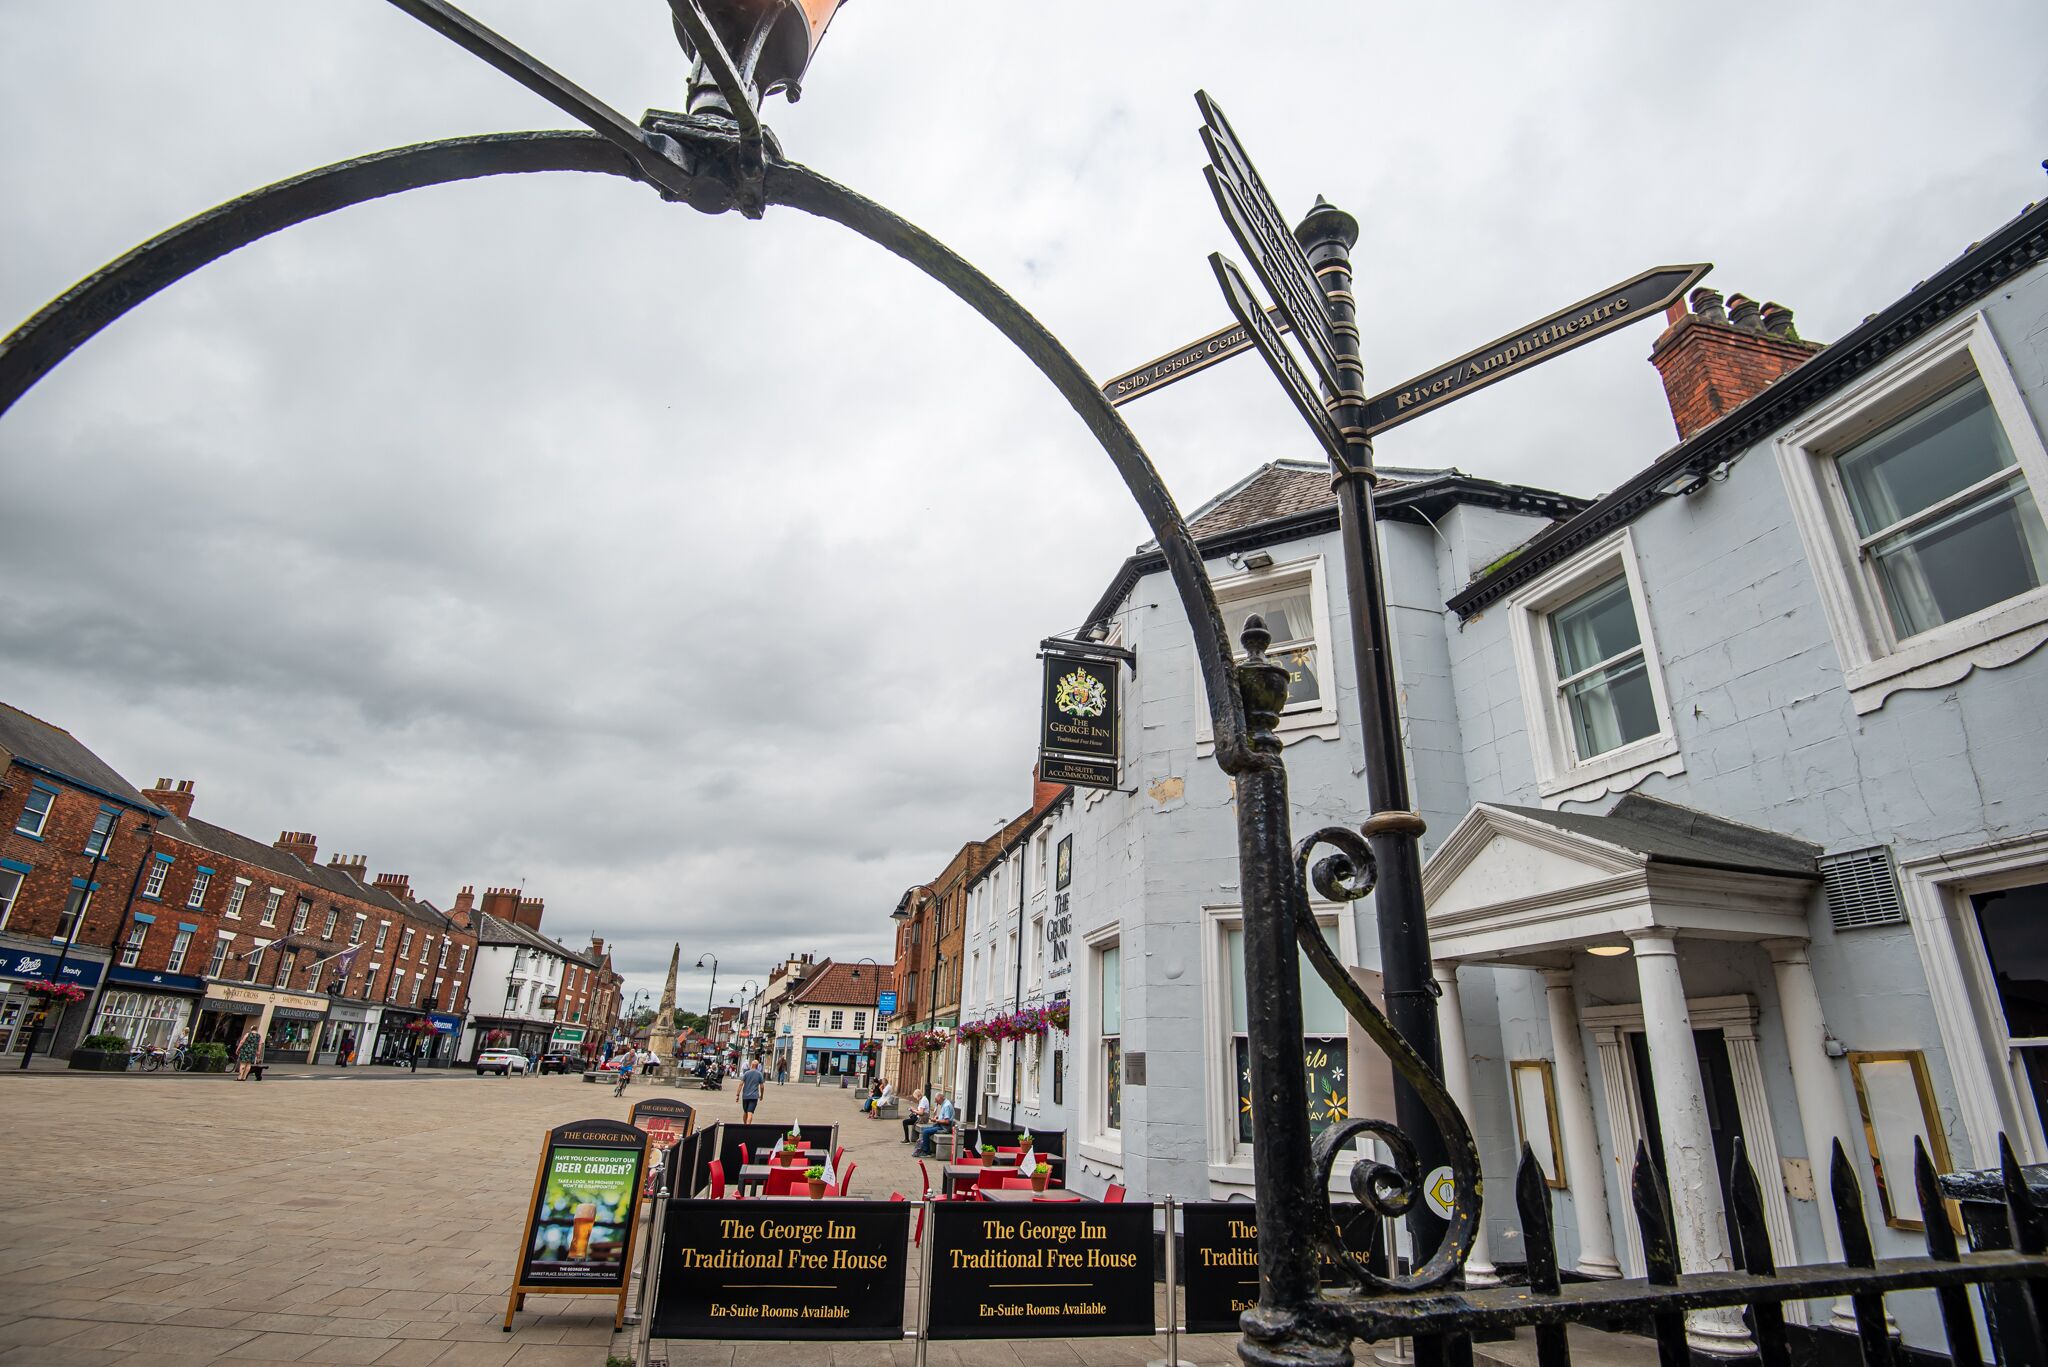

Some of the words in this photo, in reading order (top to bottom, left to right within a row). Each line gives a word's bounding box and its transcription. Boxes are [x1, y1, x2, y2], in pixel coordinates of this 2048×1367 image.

[1116, 373, 1151, 395] Selby
[1154, 350, 1204, 379] Leisure
[1207, 329, 1249, 354] Centr
[1050, 722, 1089, 735] GEORGE
[1092, 727, 1109, 737] INN
[1073, 718, 1088, 726] THE
[1048, 770, 1109, 782] ACCOMMODATION
[1065, 765, 1094, 773] EN-SUITE
[1055, 892, 1070, 917] THE
[1046, 913, 1072, 943] GEORG
[1053, 939, 1068, 963] INN
[15, 957, 41, 973] Boots
[63, 966, 81, 976] Beauty
[648, 1117, 672, 1130] HOT
[564, 1131, 581, 1140] THE
[582, 1132, 619, 1142] GEORGE
[620, 1134, 637, 1142] INN
[555, 1163, 581, 1173] BEER
[585, 1164, 632, 1175] GARDEN?
[720, 1220, 754, 1239] The
[760, 1220, 822, 1244] George
[826, 1220, 856, 1240] Inn
[983, 1220, 1014, 1240] The
[1020, 1220, 1076, 1244] George
[1080, 1221, 1107, 1239] Inn
[1228, 1221, 1257, 1239] The
[682, 1248, 783, 1269] Traditional
[787, 1249, 828, 1269] Free
[832, 1249, 887, 1269] House
[950, 1249, 1042, 1269] Traditional
[1047, 1249, 1083, 1268] Free
[1087, 1249, 1137, 1268] House
[1200, 1248, 1259, 1266] Traditio
[710, 1303, 759, 1318] En-Suite
[761, 1304, 799, 1318] Rooms
[801, 1305, 850, 1319] Available
[980, 1304, 1024, 1317] En-Suite
[1026, 1303, 1060, 1316] Rooms
[1062, 1302, 1107, 1315] Available
